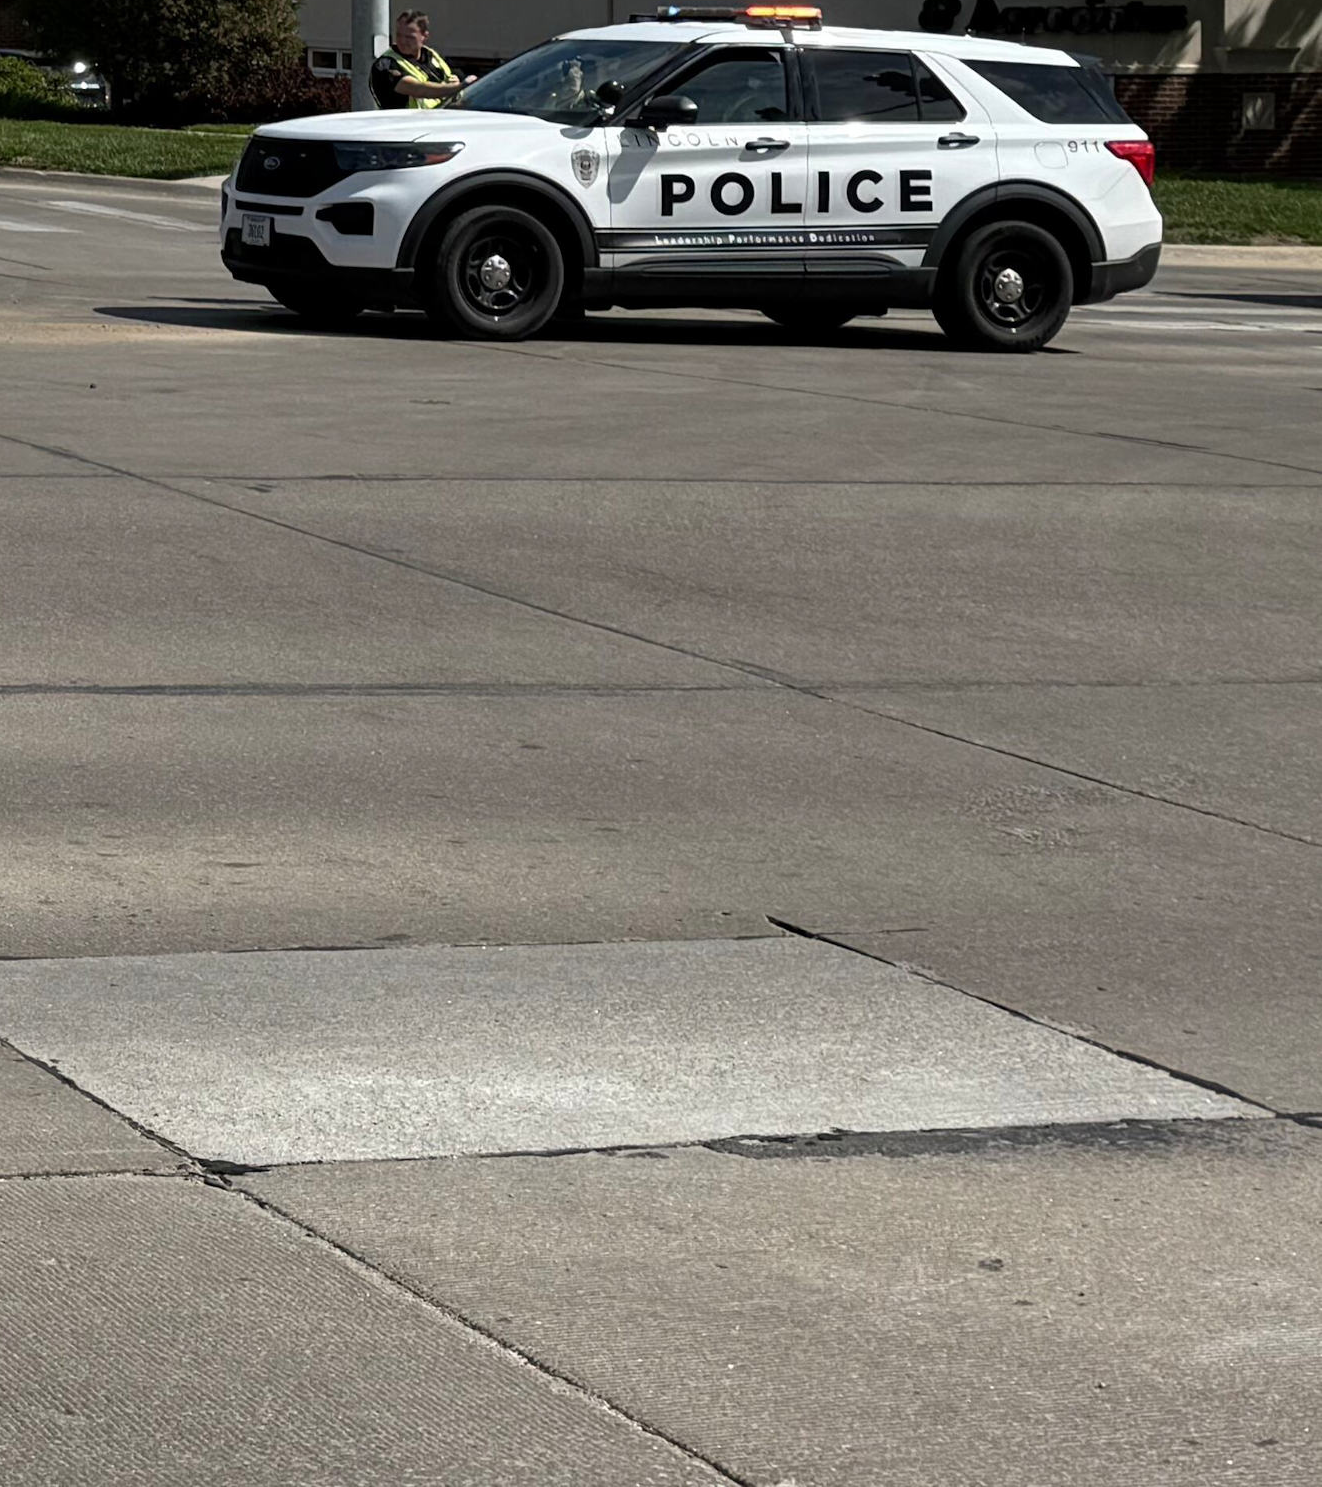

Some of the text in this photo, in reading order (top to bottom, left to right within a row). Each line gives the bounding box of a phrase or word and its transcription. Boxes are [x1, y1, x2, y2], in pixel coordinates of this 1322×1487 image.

[617, 132, 739, 148] LINCOLN
[1067, 140, 1100, 153] 911
[660, 169, 933, 216] POLICE
[654, 232, 875, 246] Leadership Performance Dedication
